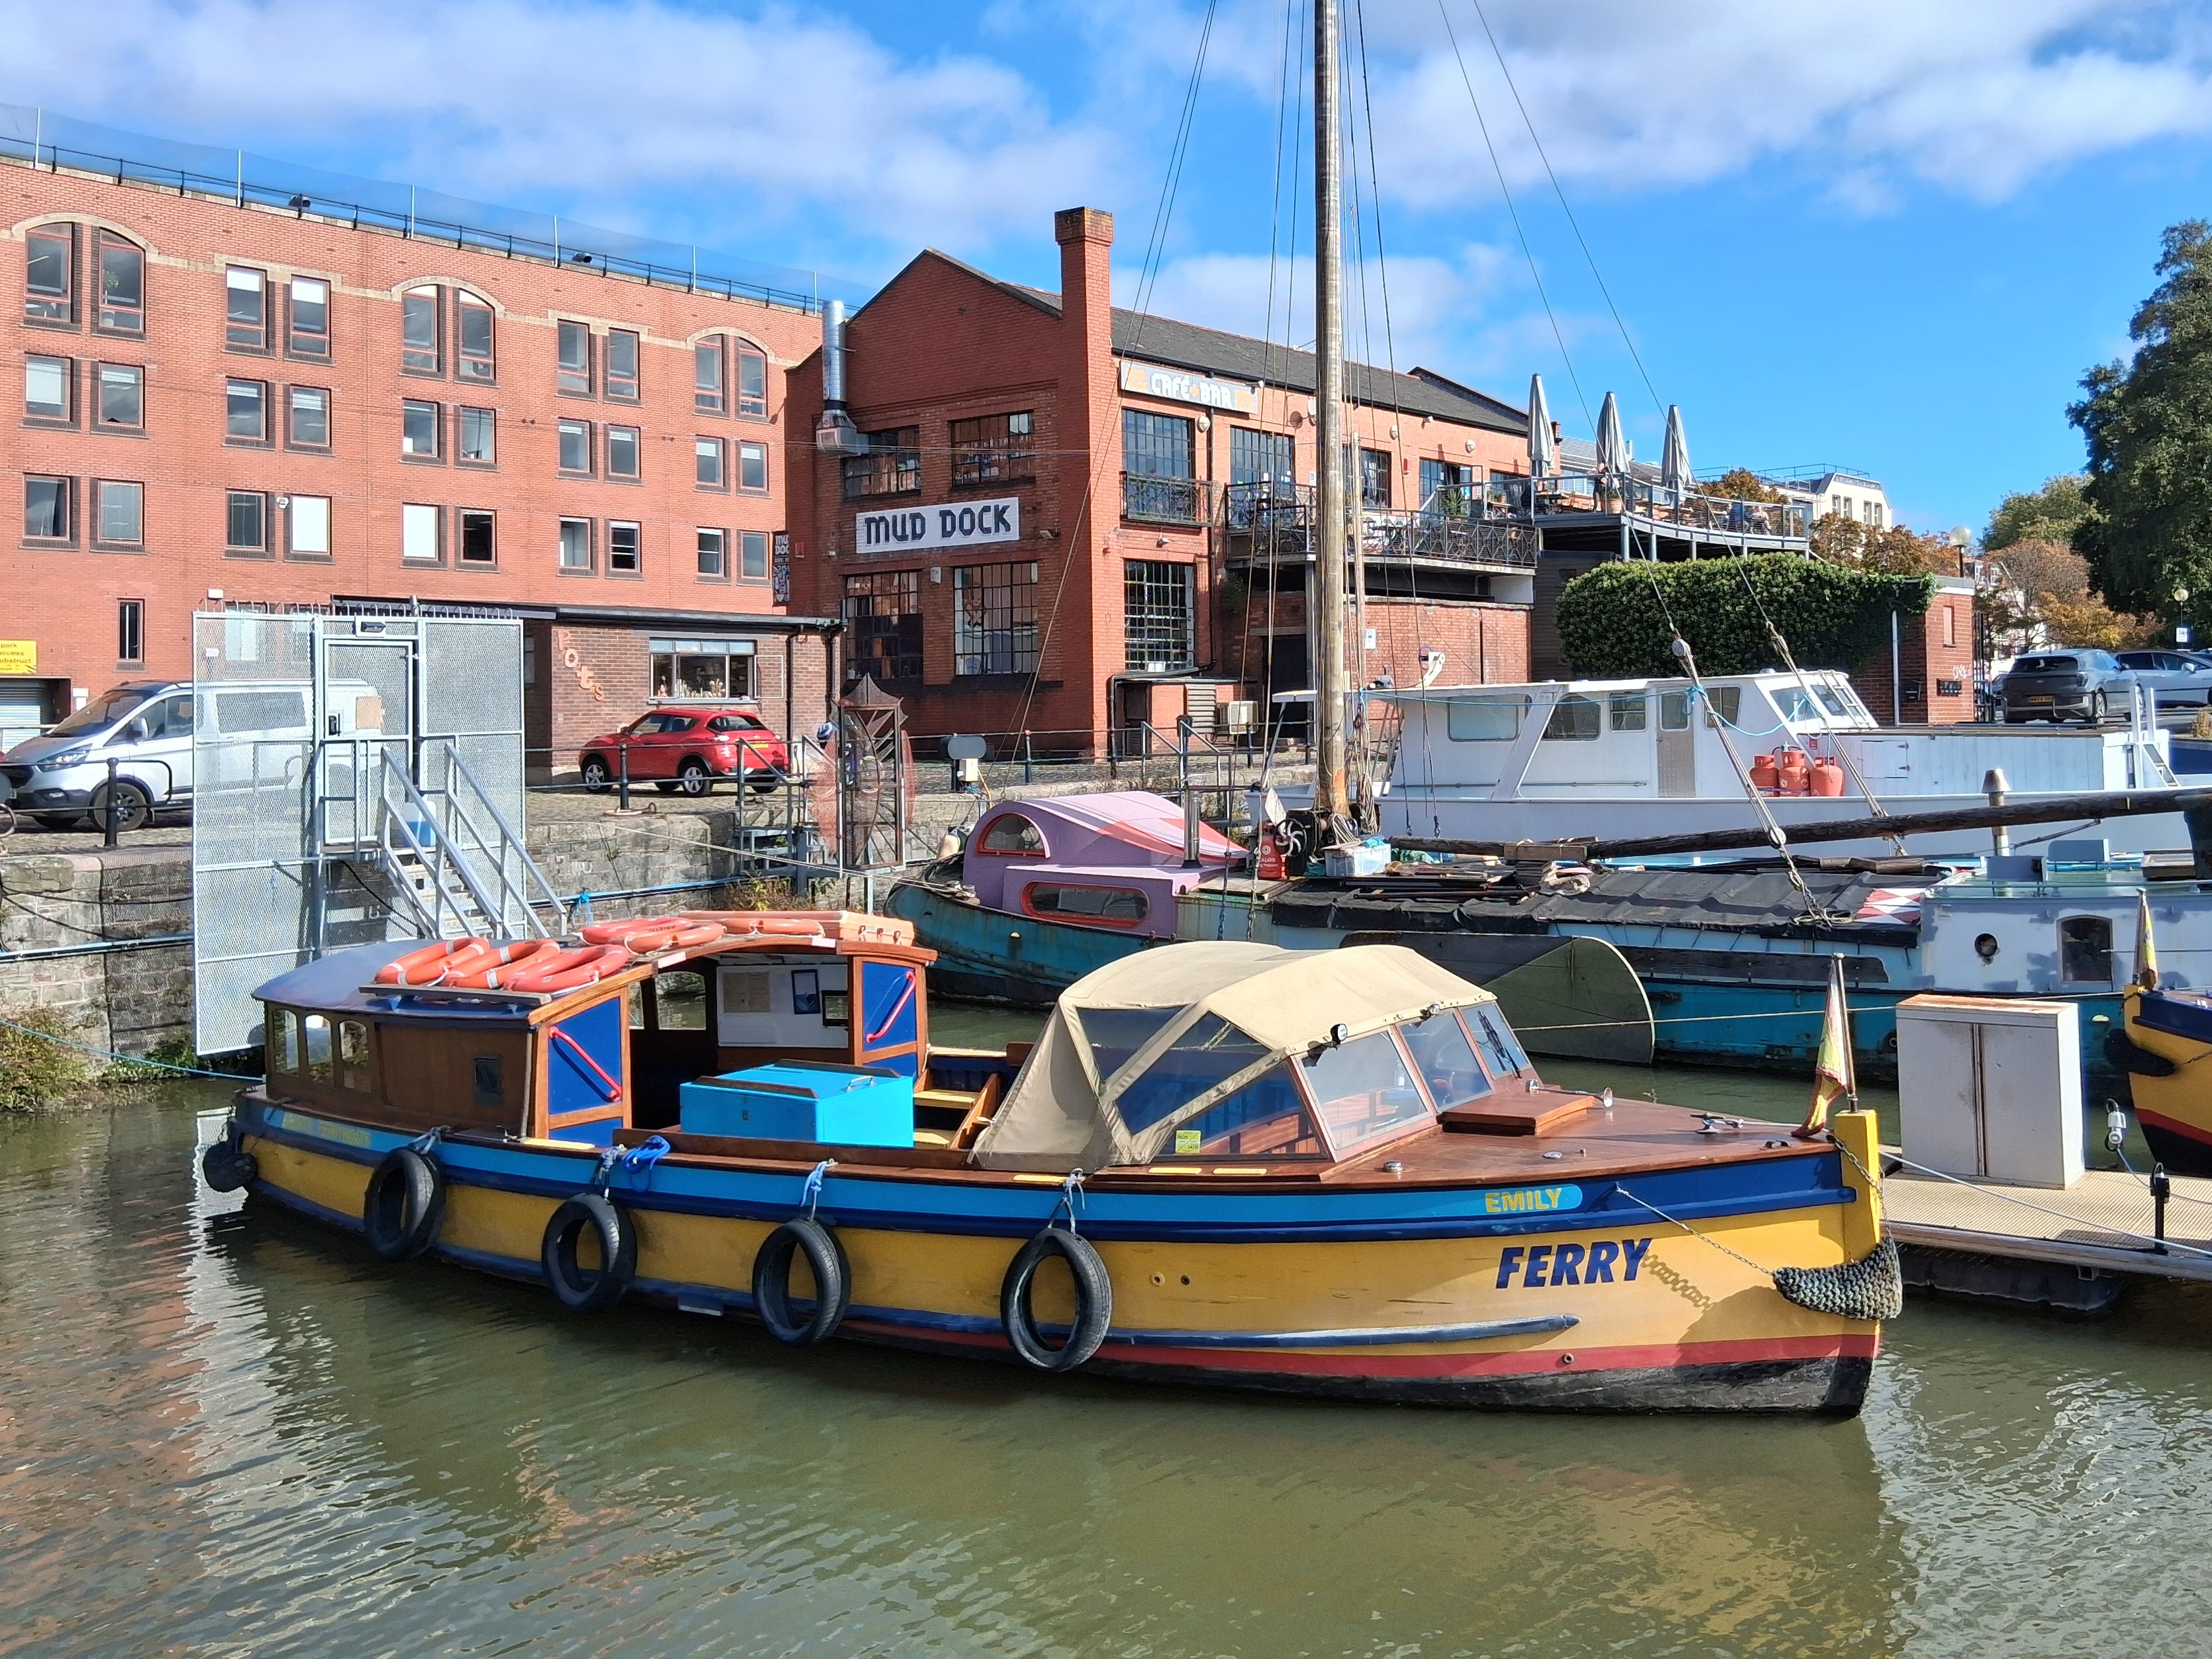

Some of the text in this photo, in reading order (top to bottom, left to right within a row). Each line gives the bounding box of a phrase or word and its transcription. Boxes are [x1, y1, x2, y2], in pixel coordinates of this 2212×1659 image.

[1151, 373, 1191, 400] CAFÉ
[1199, 381, 1232, 408] BAR
[864, 504, 1011, 545] MUD DOCK
[1485, 1187, 1562, 1212] EMILY
[1495, 1237, 1653, 1290] FERRY
